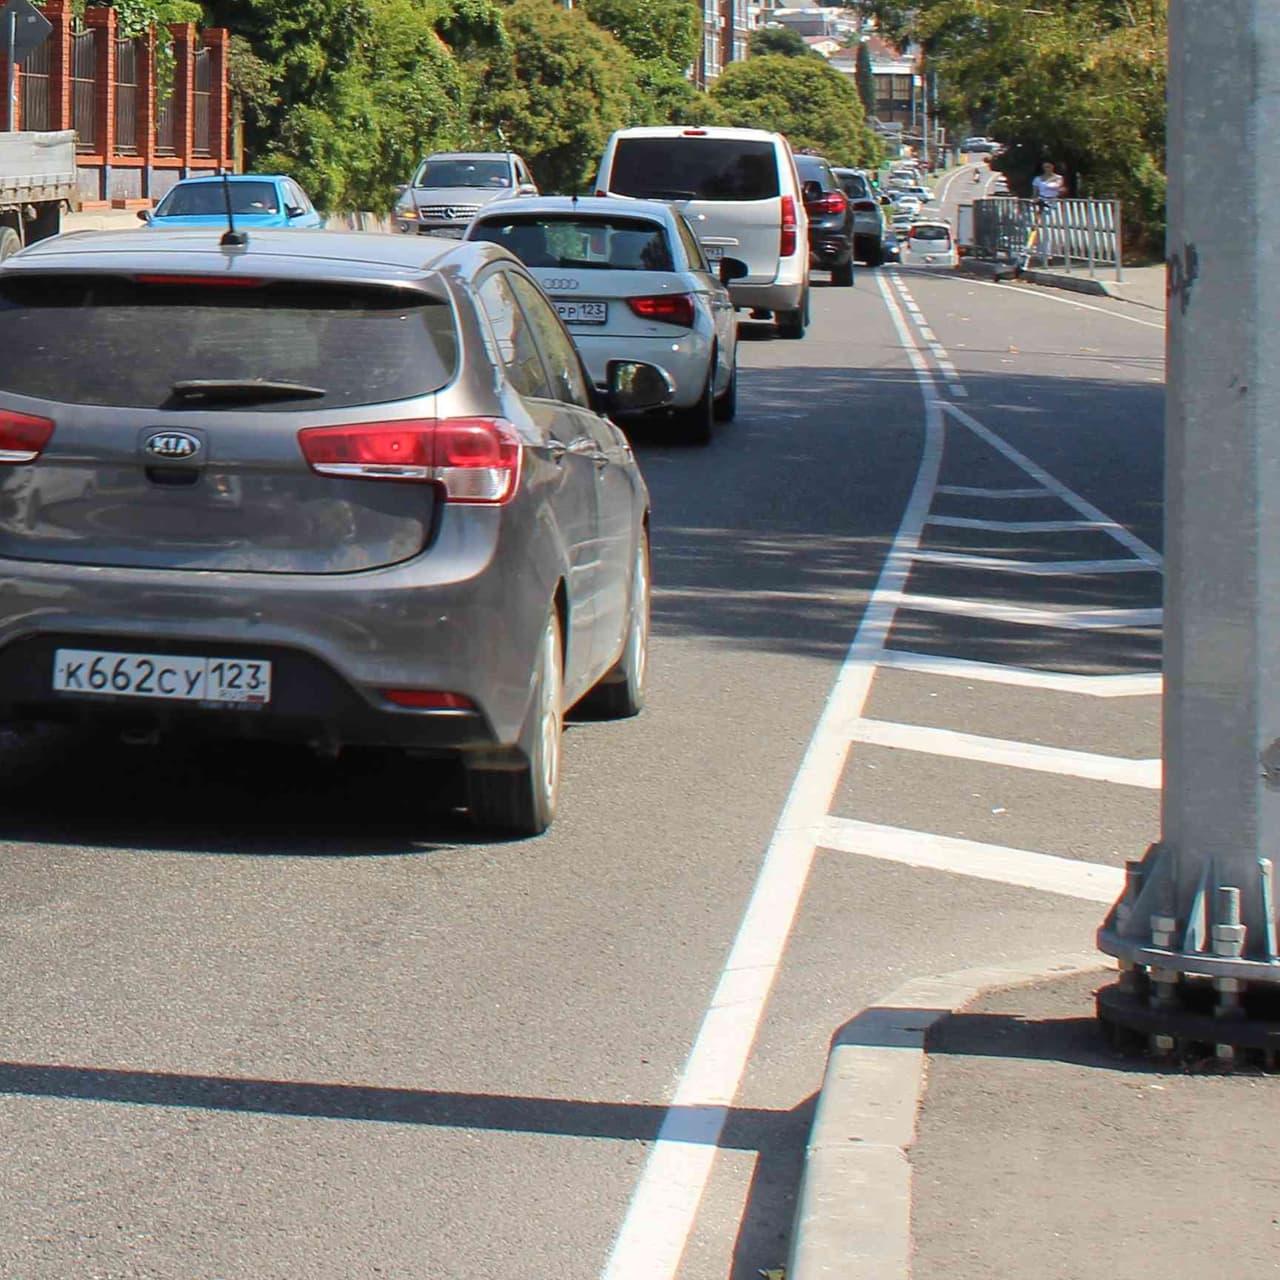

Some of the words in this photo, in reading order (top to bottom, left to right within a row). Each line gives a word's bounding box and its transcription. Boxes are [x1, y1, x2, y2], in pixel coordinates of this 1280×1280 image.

[581, 304, 601, 316] 123
[151, 436, 192, 454] KIA
[65, 656, 202, 695] К662СУ
[211, 662, 262, 690] 123
